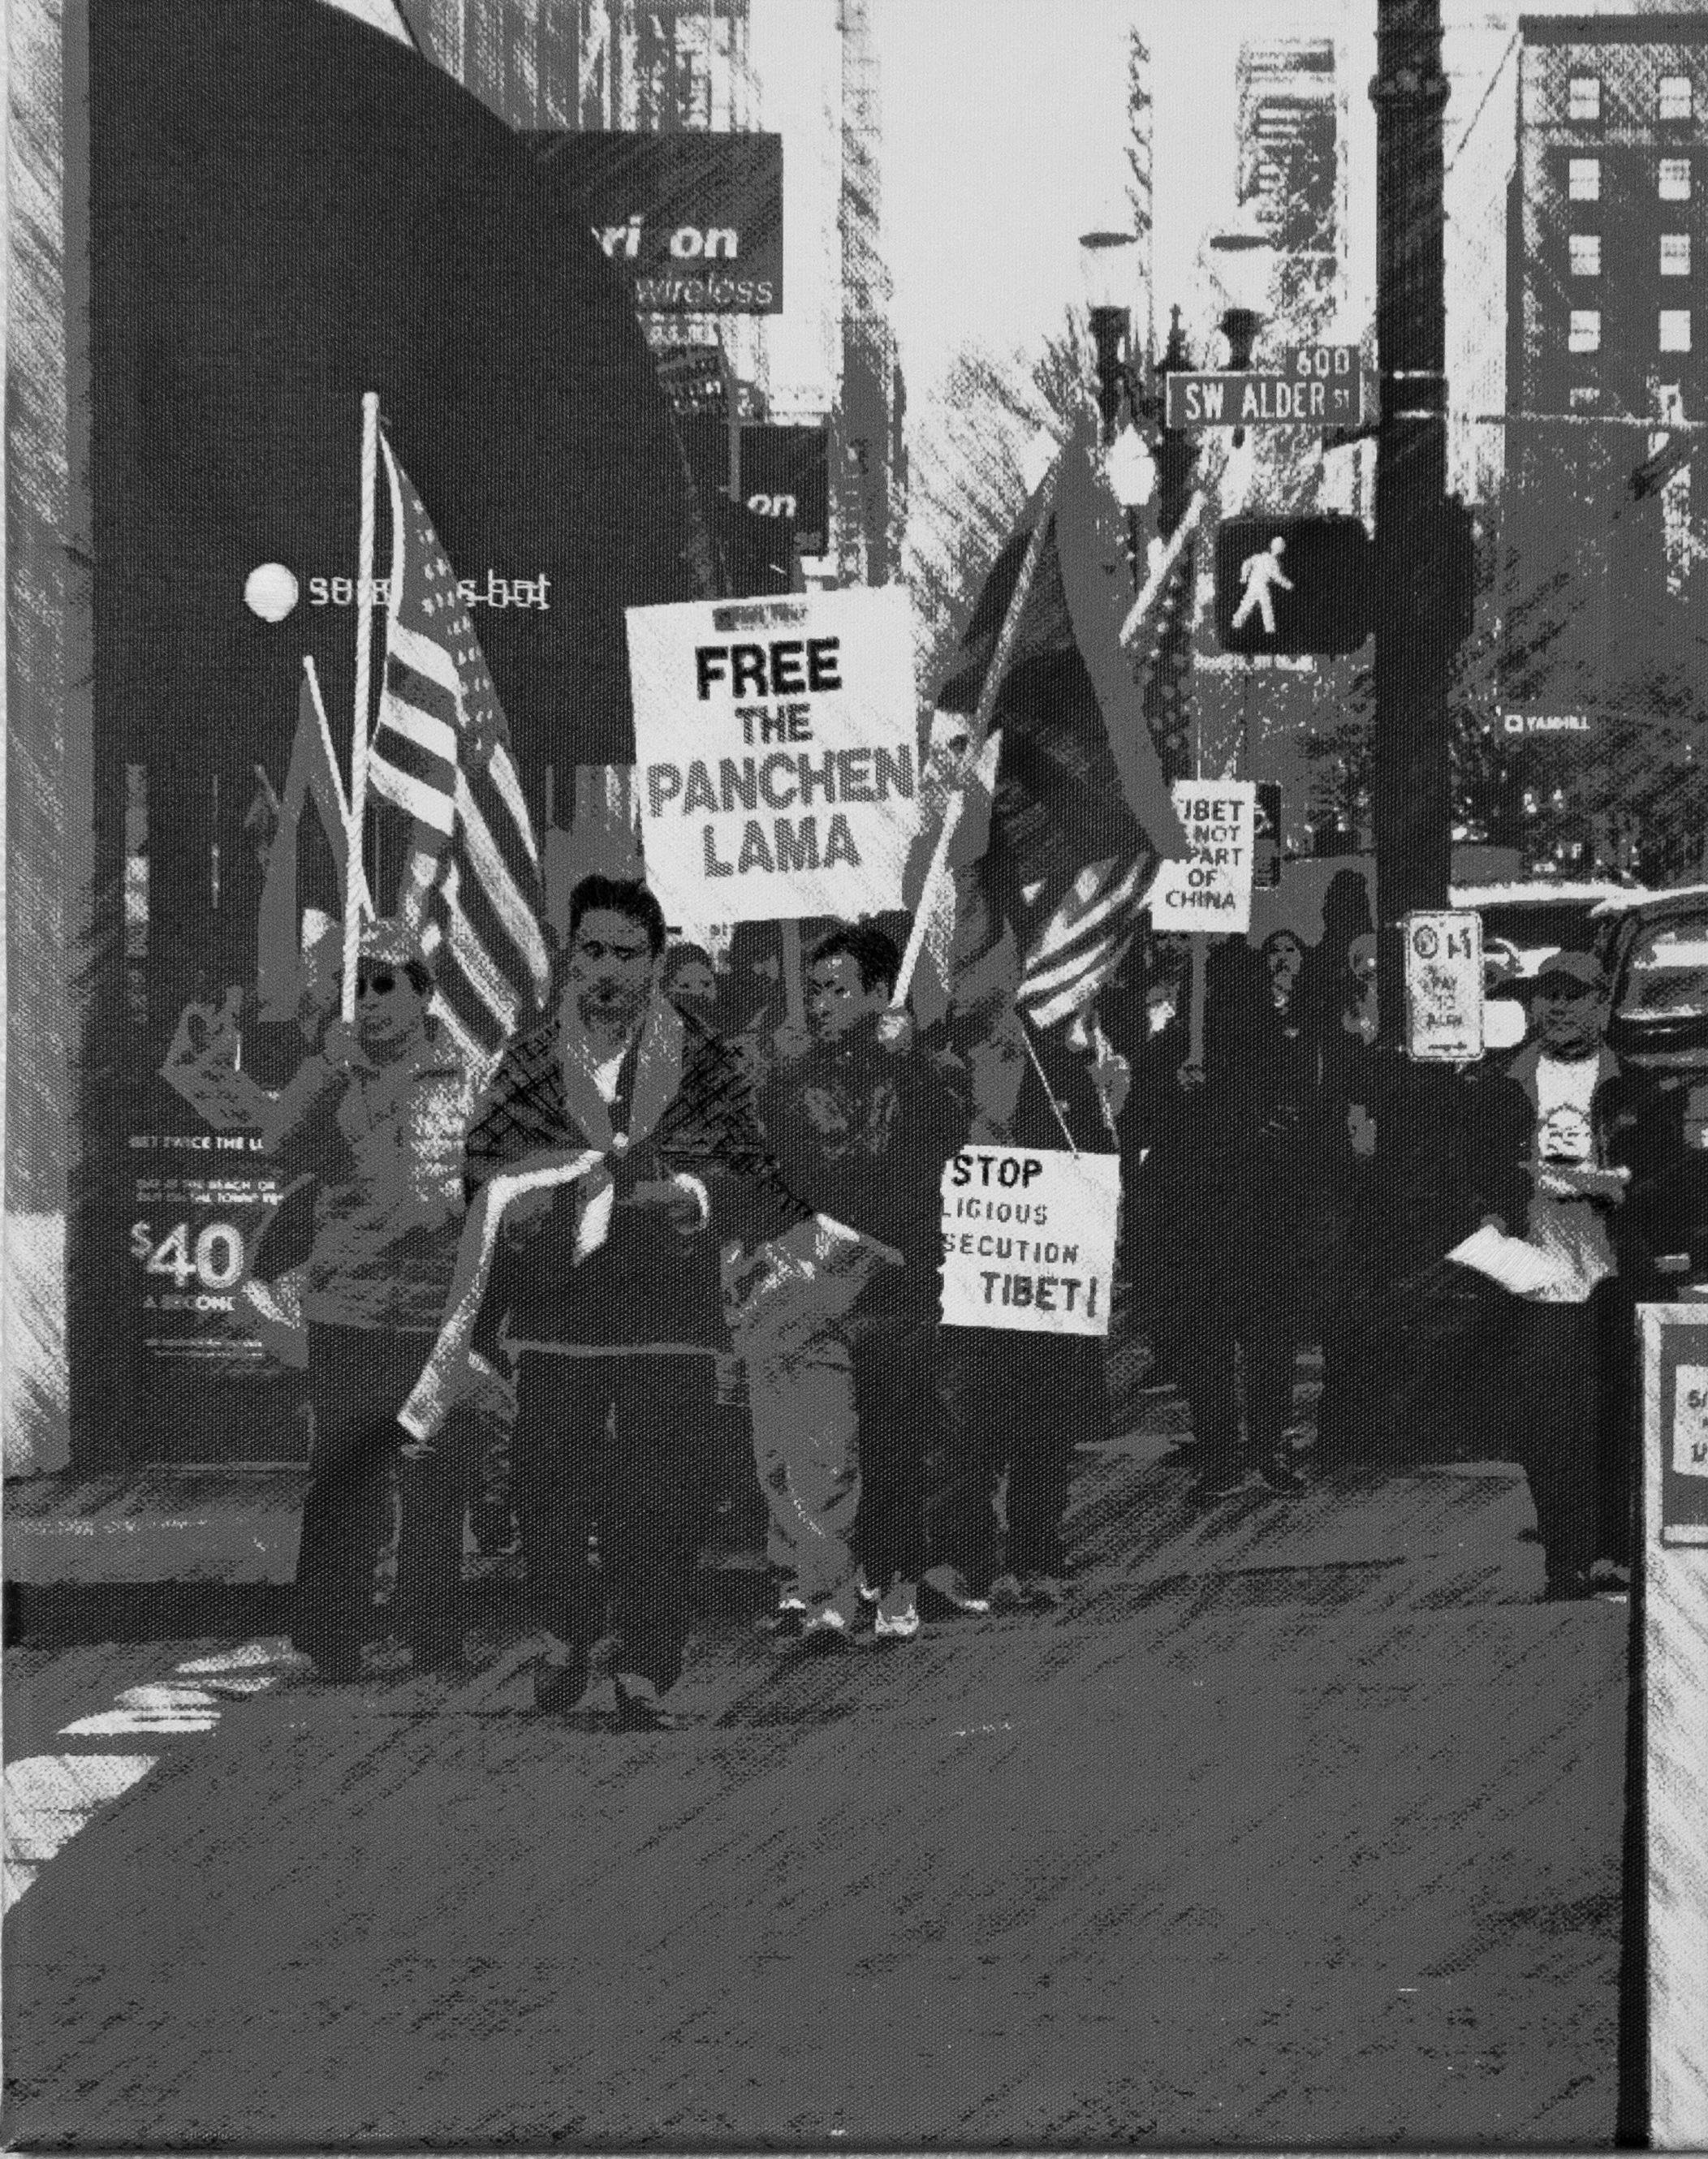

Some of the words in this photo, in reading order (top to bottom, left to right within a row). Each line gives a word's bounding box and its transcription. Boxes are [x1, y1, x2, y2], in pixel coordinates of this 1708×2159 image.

[1296, 347, 1350, 378] 600
[1185, 381, 1224, 420] SW
[1240, 381, 1326, 419] ALDER
[748, 493, 797, 517] on
[695, 636, 843, 700] FREE
[735, 703, 813, 746] THE
[647, 743, 914, 818] PANCHEN
[1178, 799, 1245, 821] IBET
[702, 812, 862, 878] LAMA
[1193, 825, 1241, 842] NOT
[1188, 868, 1218, 887] OF
[1165, 890, 1236, 910] CHINA
[216, 1137, 244, 1149] THE
[951, 1154, 1043, 1188] STOP
